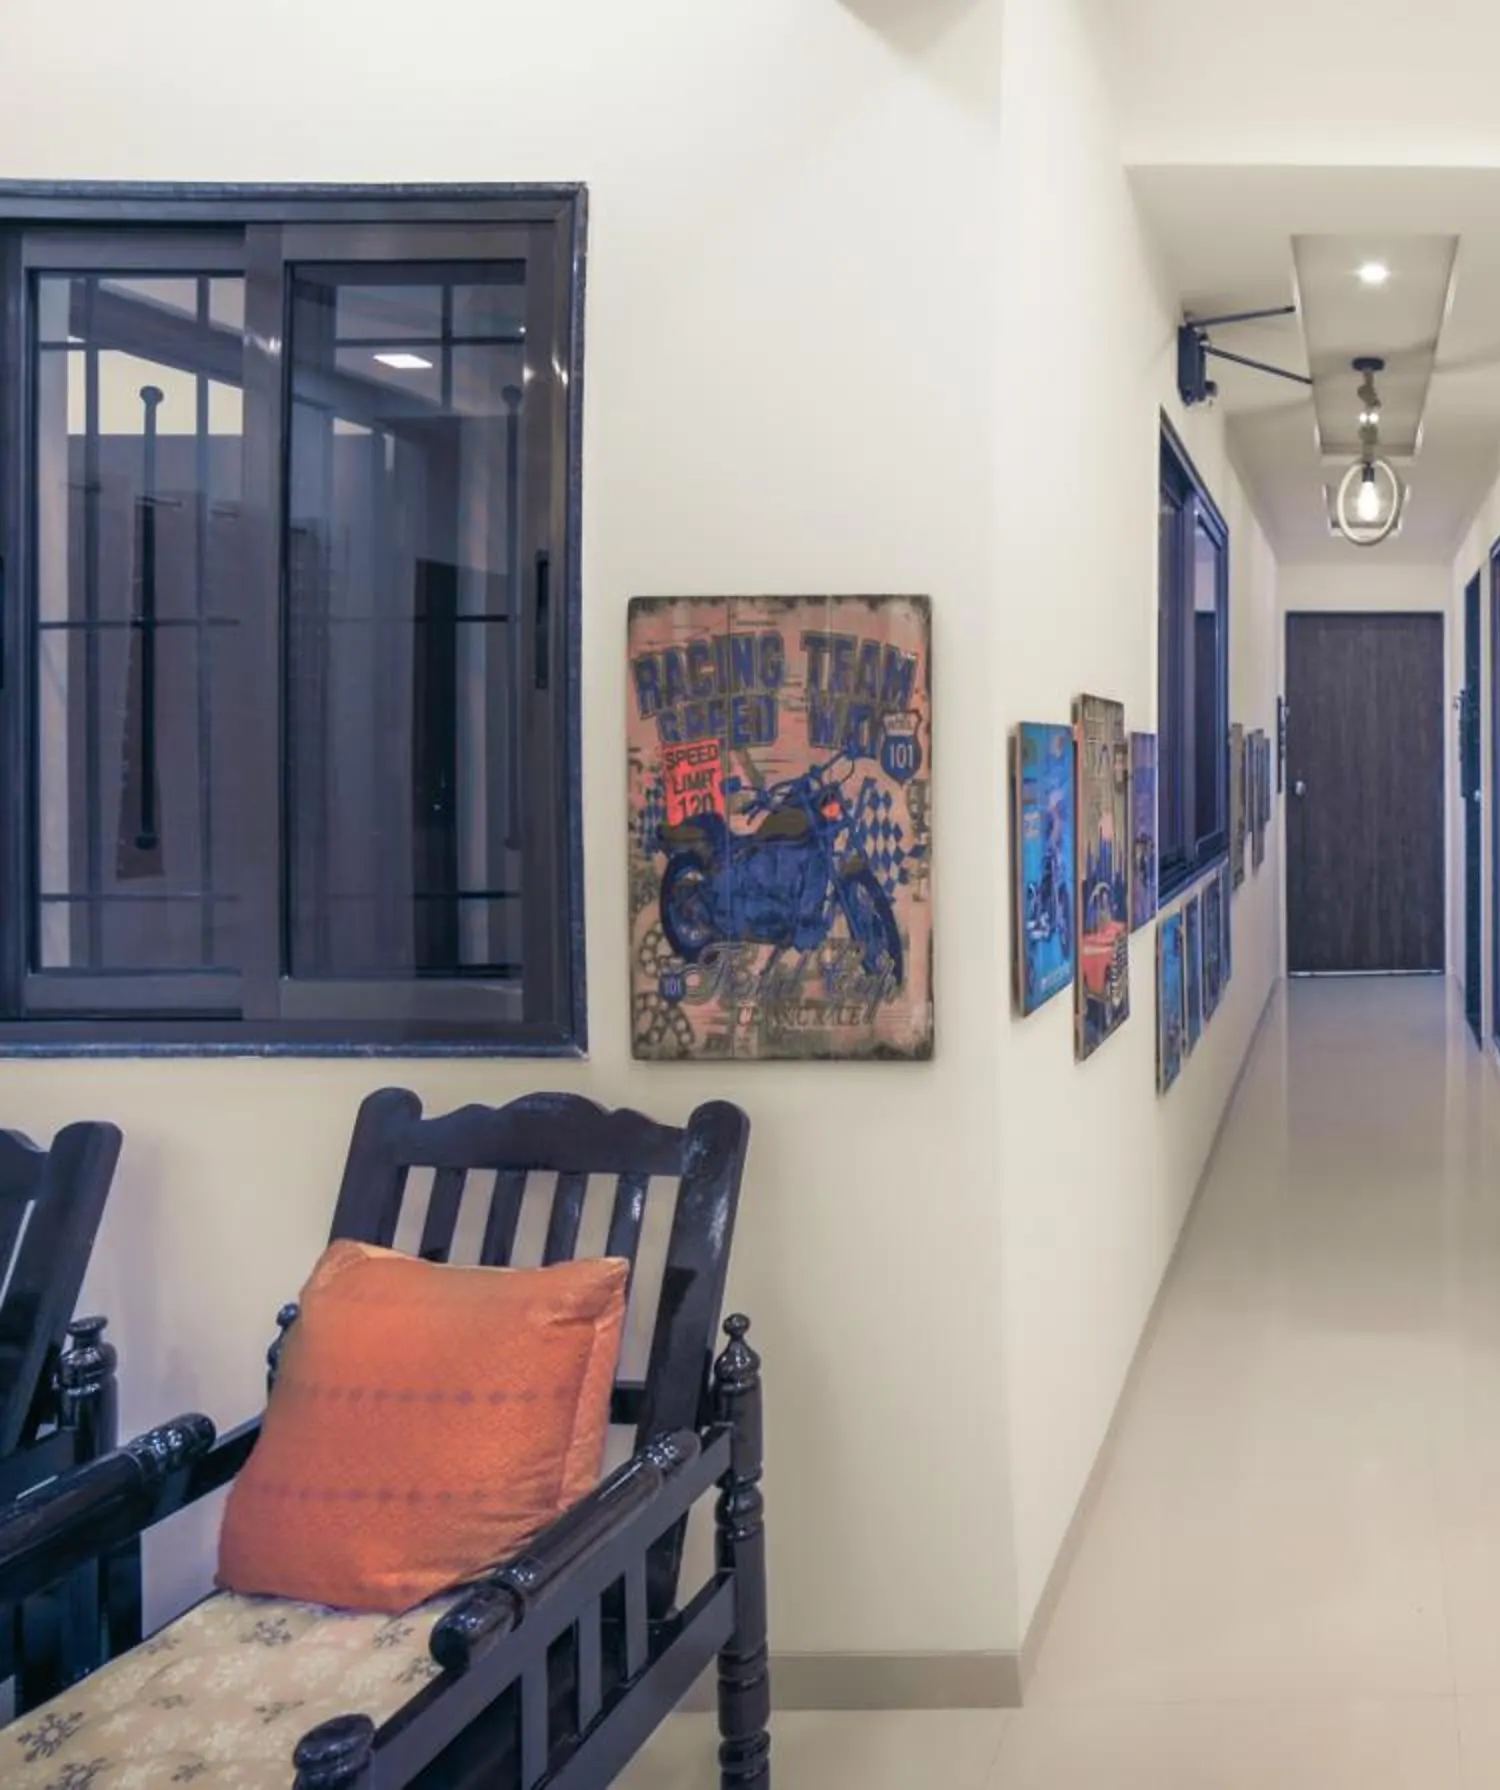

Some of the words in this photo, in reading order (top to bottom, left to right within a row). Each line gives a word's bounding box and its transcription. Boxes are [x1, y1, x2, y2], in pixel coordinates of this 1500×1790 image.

[632, 630, 785, 719] RACING
[801, 630, 918, 710] TEAM
[666, 744, 718, 769] SPEED
[889, 743, 914, 769] 101
[673, 767, 716, 795] LIMIT
